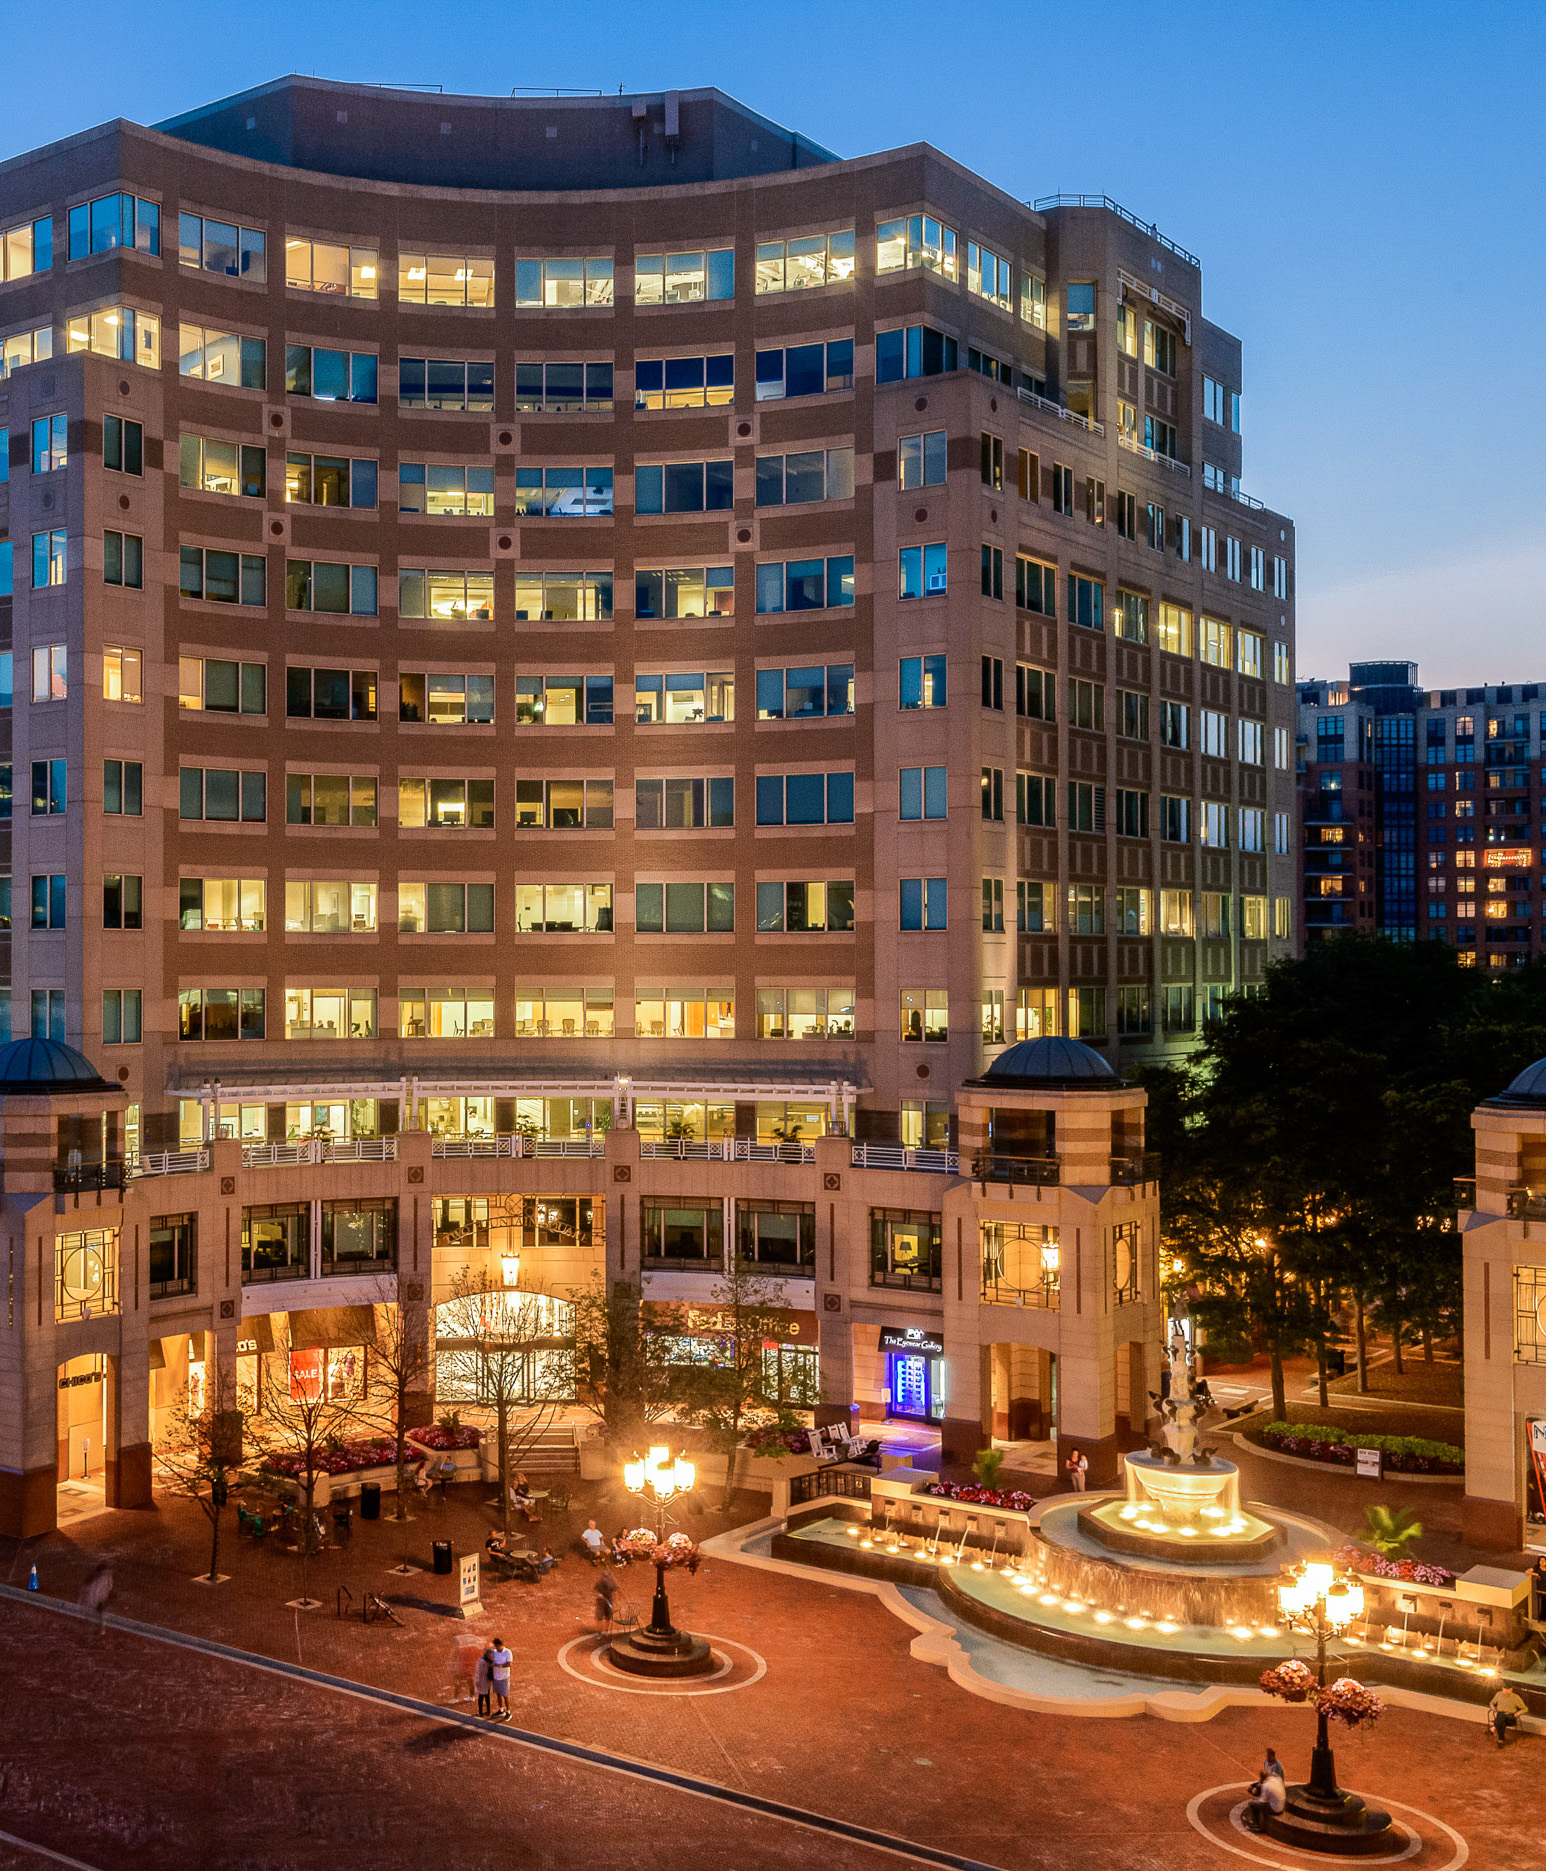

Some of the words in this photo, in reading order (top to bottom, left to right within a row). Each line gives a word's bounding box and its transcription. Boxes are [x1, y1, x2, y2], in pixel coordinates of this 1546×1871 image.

[476, 1216, 536, 1230] FUNTAIN
[884, 1335, 897, 1345] The
[921, 1340, 943, 1352] Gallery
[59, 1371, 102, 1389] CHICO'S
[294, 1369, 318, 1380] SALE
